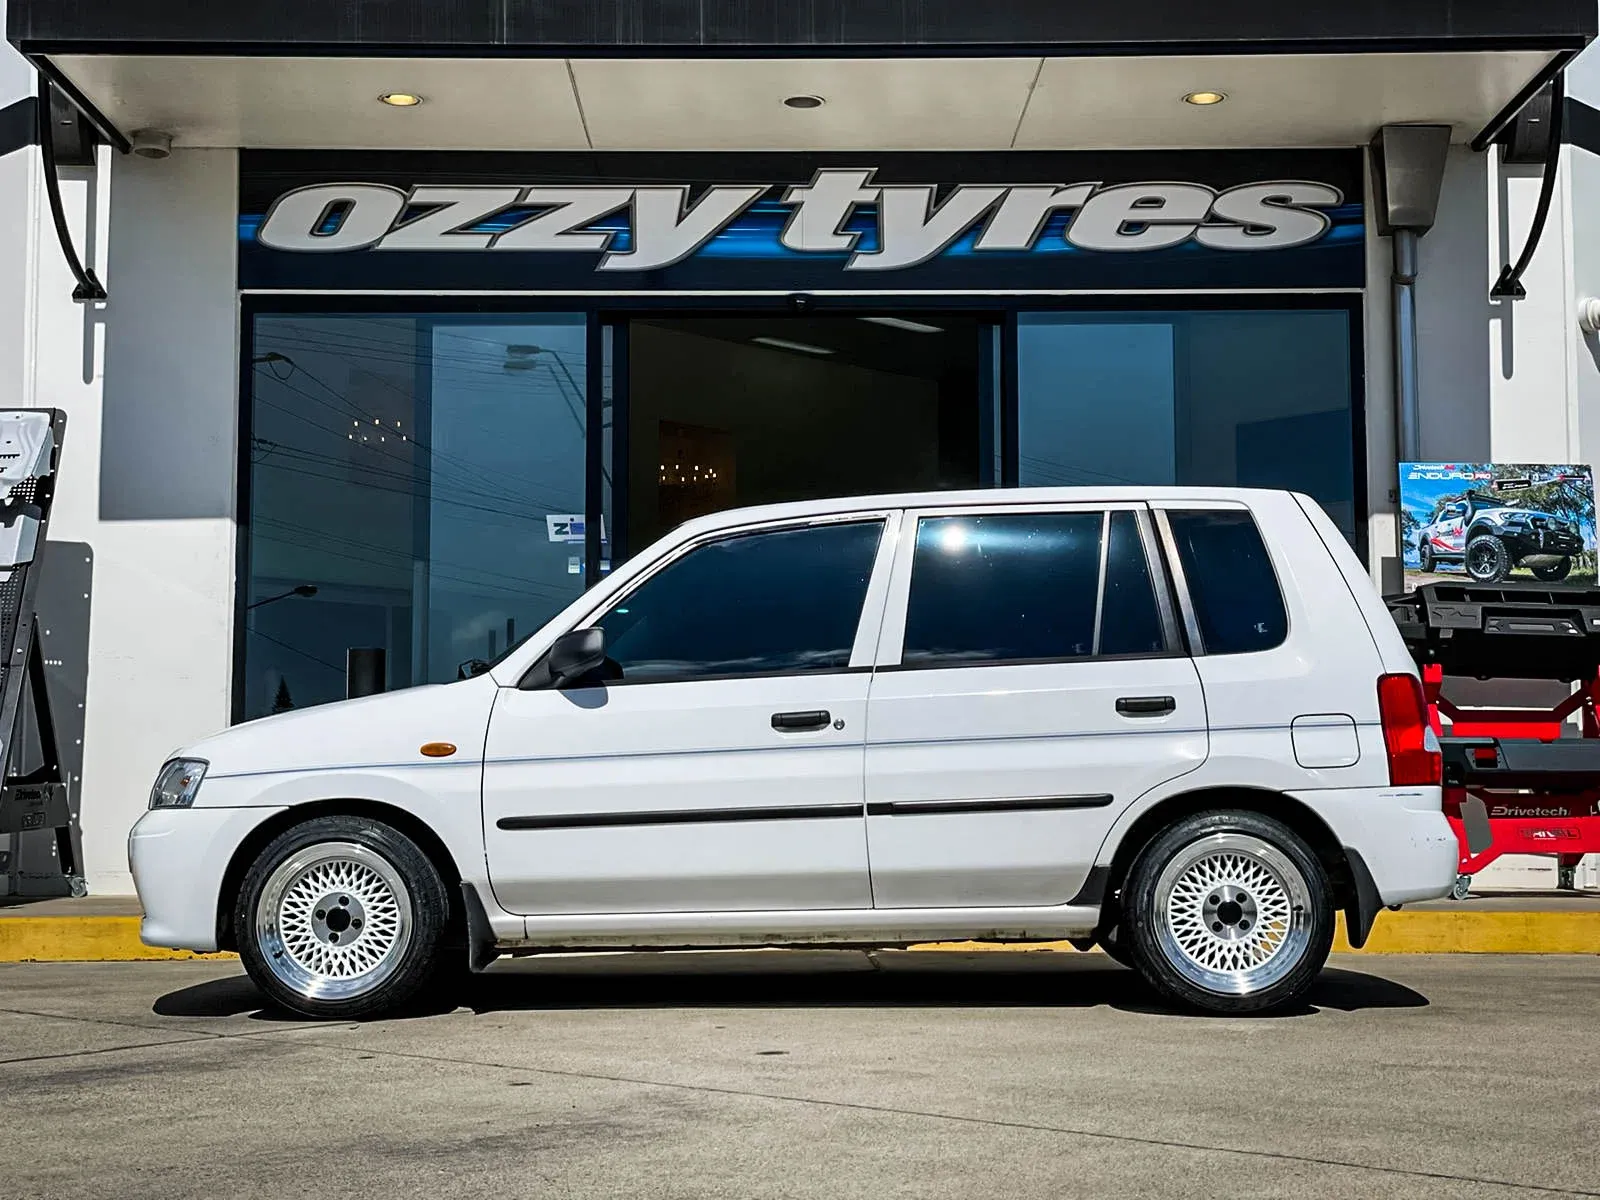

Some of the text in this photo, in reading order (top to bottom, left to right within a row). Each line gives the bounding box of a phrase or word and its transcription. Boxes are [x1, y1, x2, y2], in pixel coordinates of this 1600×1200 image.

[256, 167, 1345, 272] ozzy tyres
[1407, 472, 1474, 480] ENDURO
[1490, 806, 1568, 816] Drivetech
